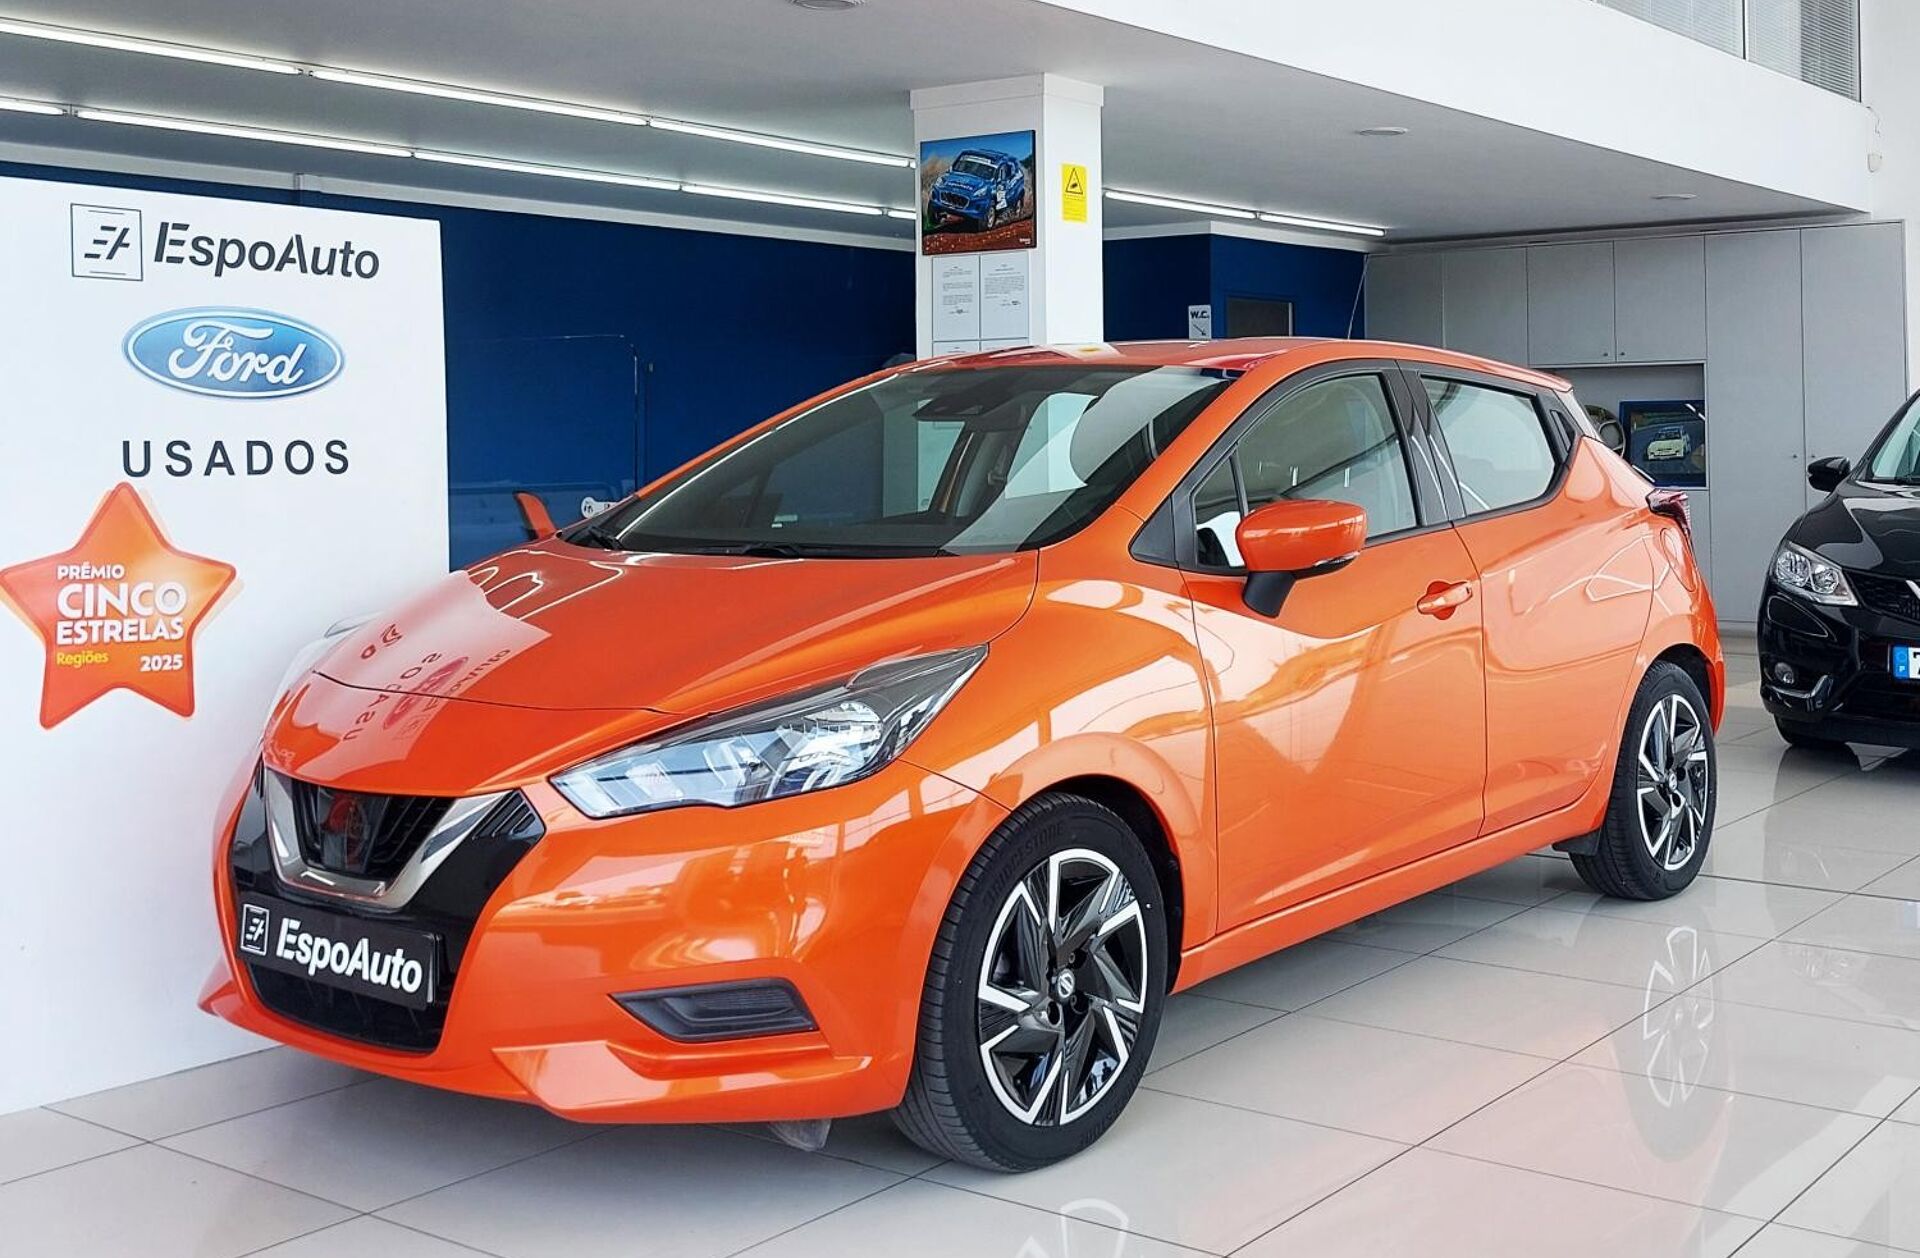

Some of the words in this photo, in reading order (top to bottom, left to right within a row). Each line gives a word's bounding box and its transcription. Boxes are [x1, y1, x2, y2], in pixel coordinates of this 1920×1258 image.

[153, 221, 380, 279] EspoAuto
[1190, 310, 1210, 319] W.C.
[168, 320, 306, 385] Ford
[122, 439, 350, 478] USADOS
[57, 562, 125, 580] PRÉMIO
[57, 581, 187, 619] CINCO
[56, 618, 184, 645] ESTRELAS
[56, 651, 109, 668] Regiões
[140, 654, 183, 672] 2025
[276, 917, 423, 994] EspoAuto
